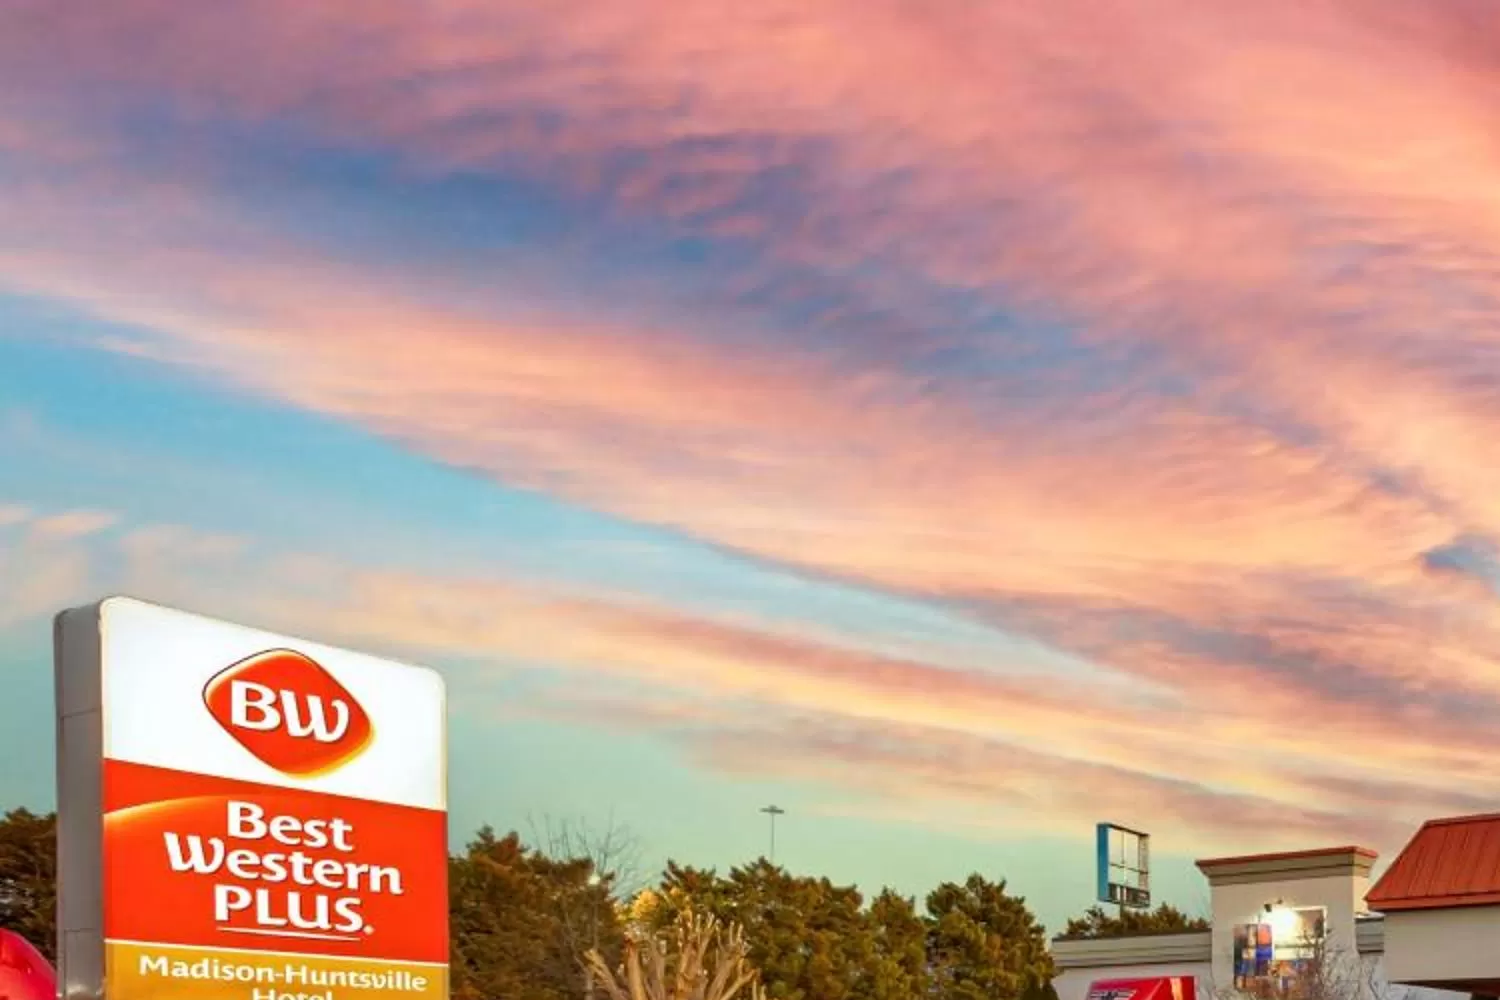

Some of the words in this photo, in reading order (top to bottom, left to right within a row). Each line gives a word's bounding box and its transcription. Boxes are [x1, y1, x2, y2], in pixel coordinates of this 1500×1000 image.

[230, 680, 350, 743] BW
[227, 801, 354, 852] Best
[163, 831, 403, 894] Western
[139, 954, 429, 992] Madison-Huntsville
